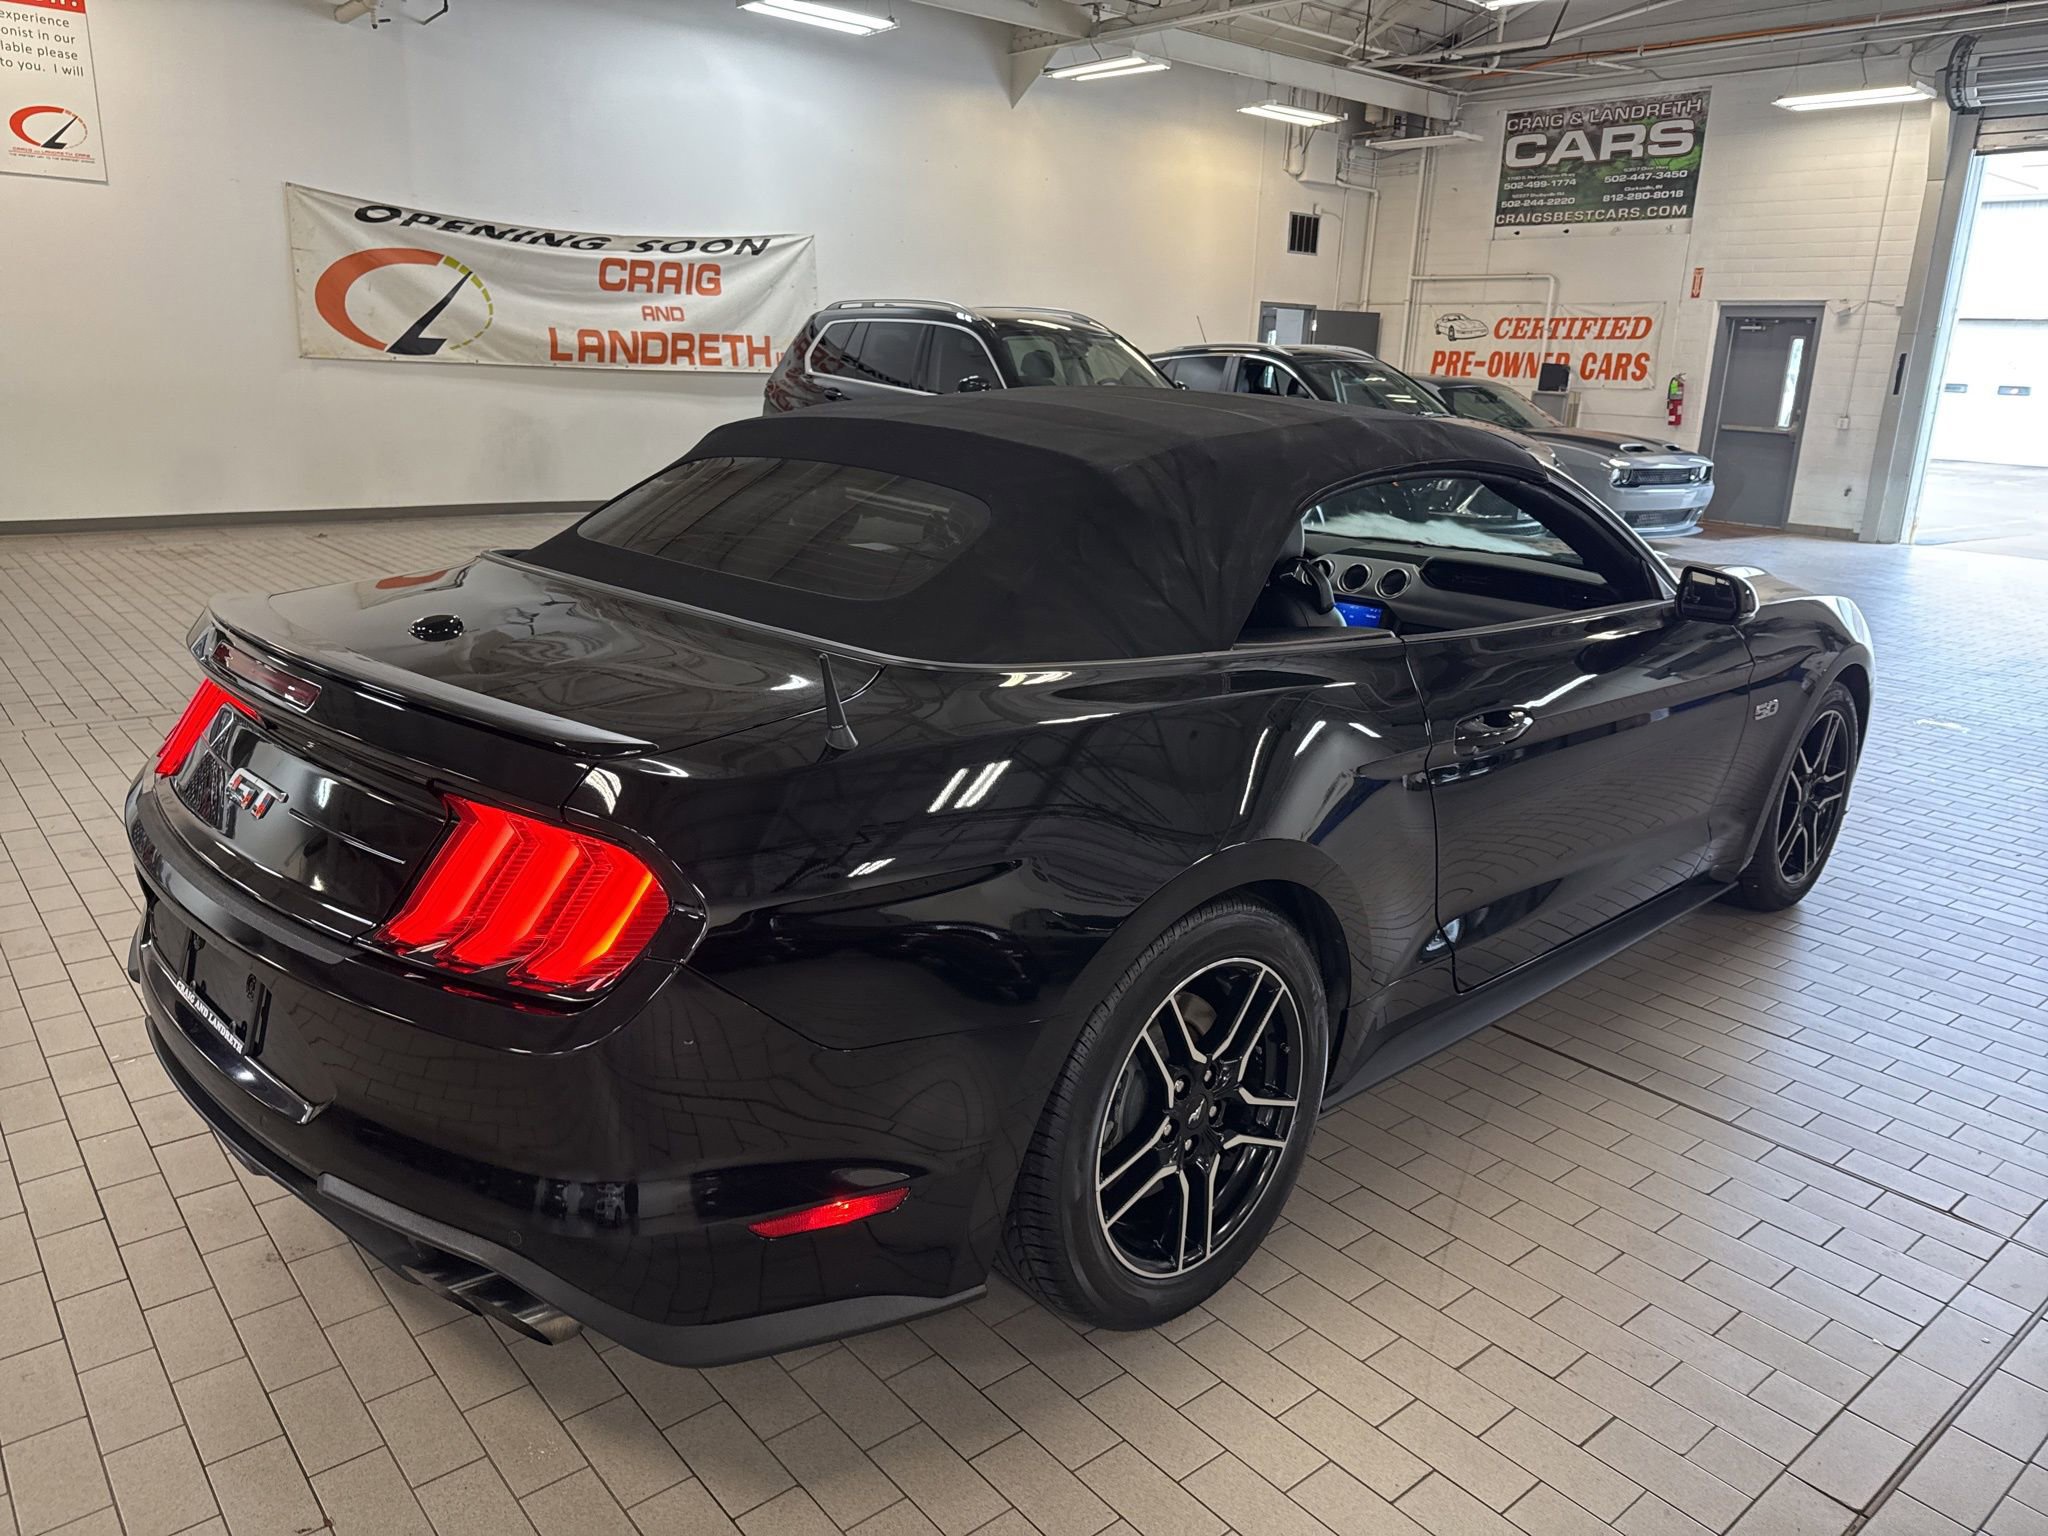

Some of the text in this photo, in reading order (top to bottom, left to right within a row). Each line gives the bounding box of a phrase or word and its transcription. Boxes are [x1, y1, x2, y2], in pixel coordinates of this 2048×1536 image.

[38, 29, 50, 41] in
[54, 34, 76, 44] our
[37, 46, 78, 60] please
[18, 61, 46, 72] you.
[61, 66, 84, 77] will
[1507, 99, 1702, 132] CRAIG & LANDRETH
[1505, 118, 1695, 169] CARS
[1503, 179, 1576, 190] 502-499-1774
[1604, 170, 1688, 183] 502-447-3450
[1501, 197, 1576, 208] 502-244-2220
[1602, 190, 1684, 202] 812-280-8018
[1496, 205, 1687, 225] CRAIGSBESTCARS.COM
[354, 205, 772, 257] OPENING SOON
[599, 257, 722, 297] CRAIG
[642, 305, 686, 322] AND
[1493, 316, 1653, 340] CERTIFIED
[548, 327, 772, 368] LANDRETH
[1579, 352, 1651, 381] CARS
[226, 768, 290, 821] GT
[176, 980, 244, 1055] CRAIG AND LANDRETH
